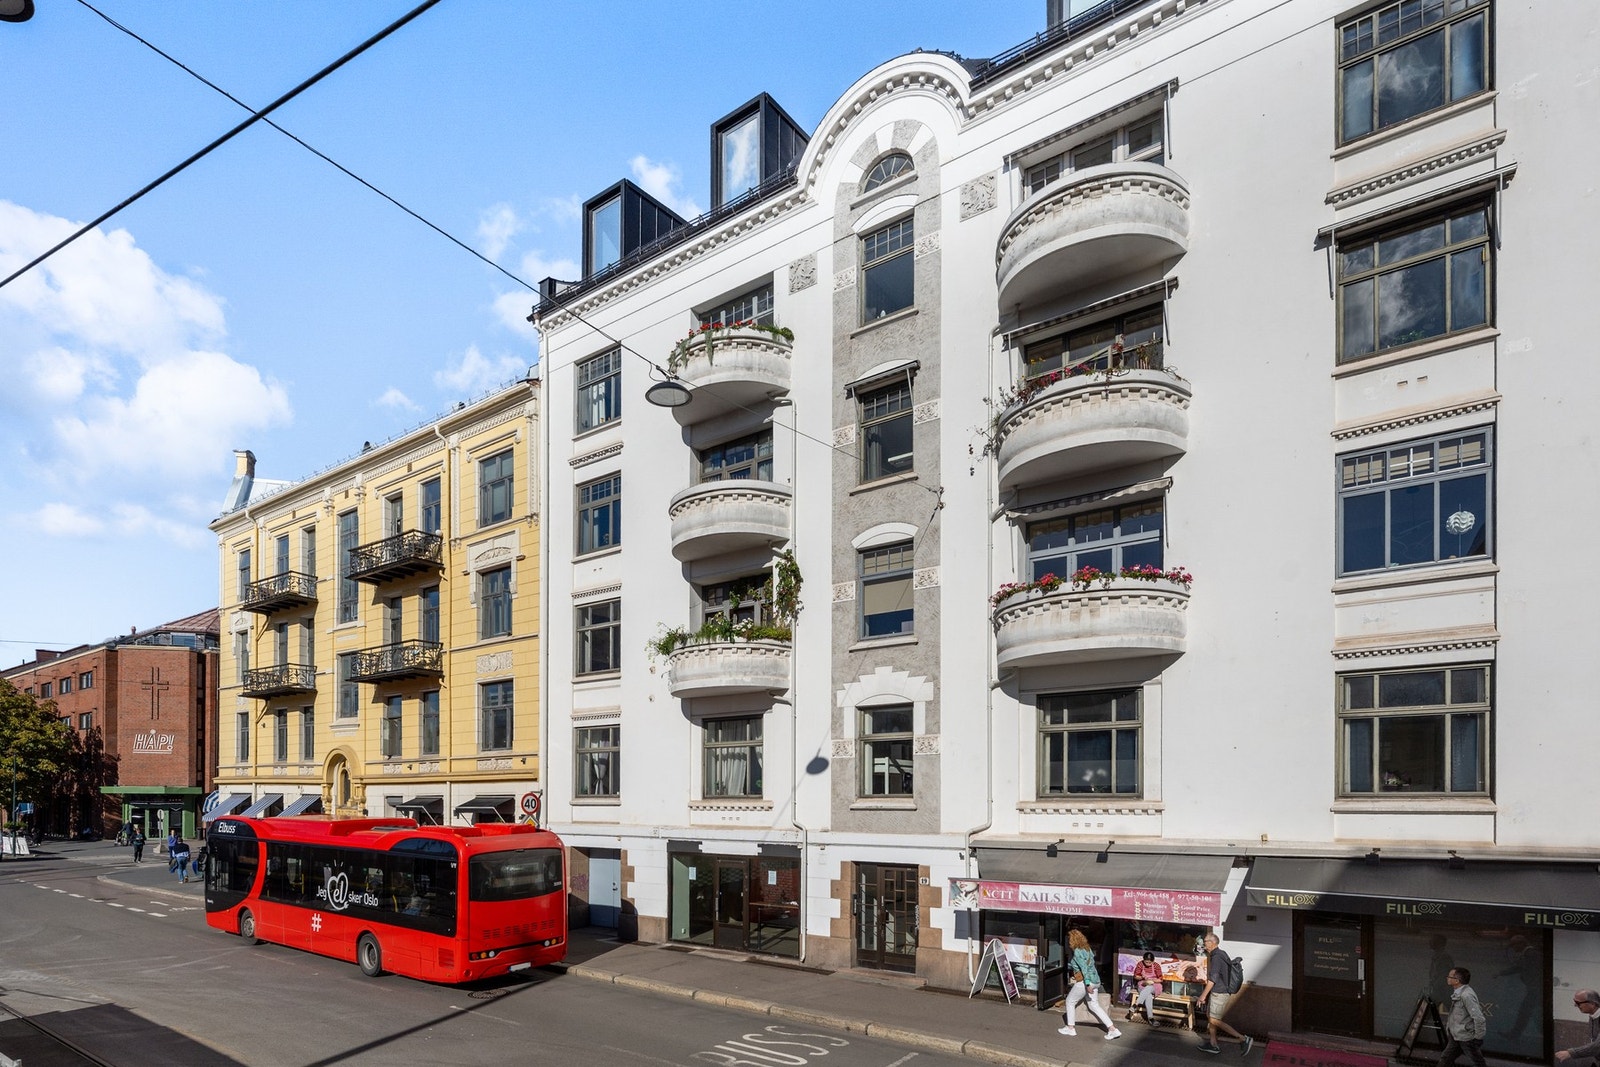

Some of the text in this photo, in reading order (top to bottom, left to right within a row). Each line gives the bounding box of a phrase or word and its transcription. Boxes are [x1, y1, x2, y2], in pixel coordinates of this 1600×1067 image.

[132, 729, 175, 751] HÅP!
[524, 798, 537, 810] 40
[218, 821, 237, 834] Elbuss
[316, 885, 327, 901] Jeg
[363, 892, 379, 907] Oslo
[1020, 891, 1061, 902] NAILS
[1083, 894, 1110, 906] SPA
